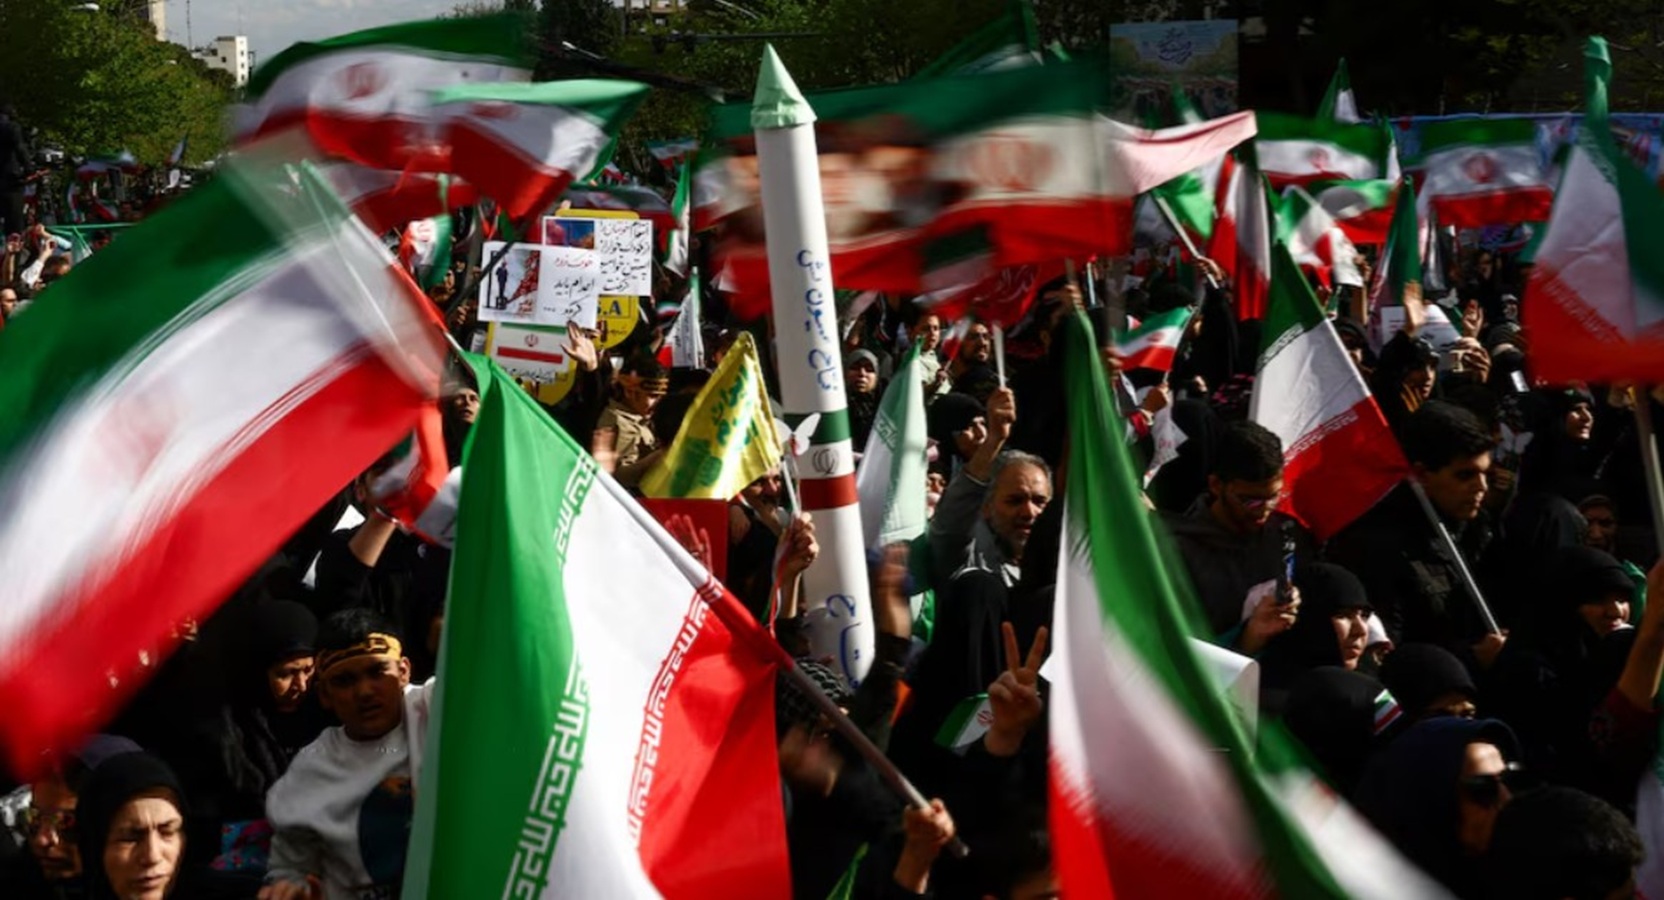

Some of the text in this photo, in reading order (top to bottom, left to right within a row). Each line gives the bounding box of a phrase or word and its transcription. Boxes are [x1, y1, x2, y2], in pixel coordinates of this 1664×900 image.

[554, 276, 595, 299] اعدام باید
[808, 348, 838, 392] فتاح
